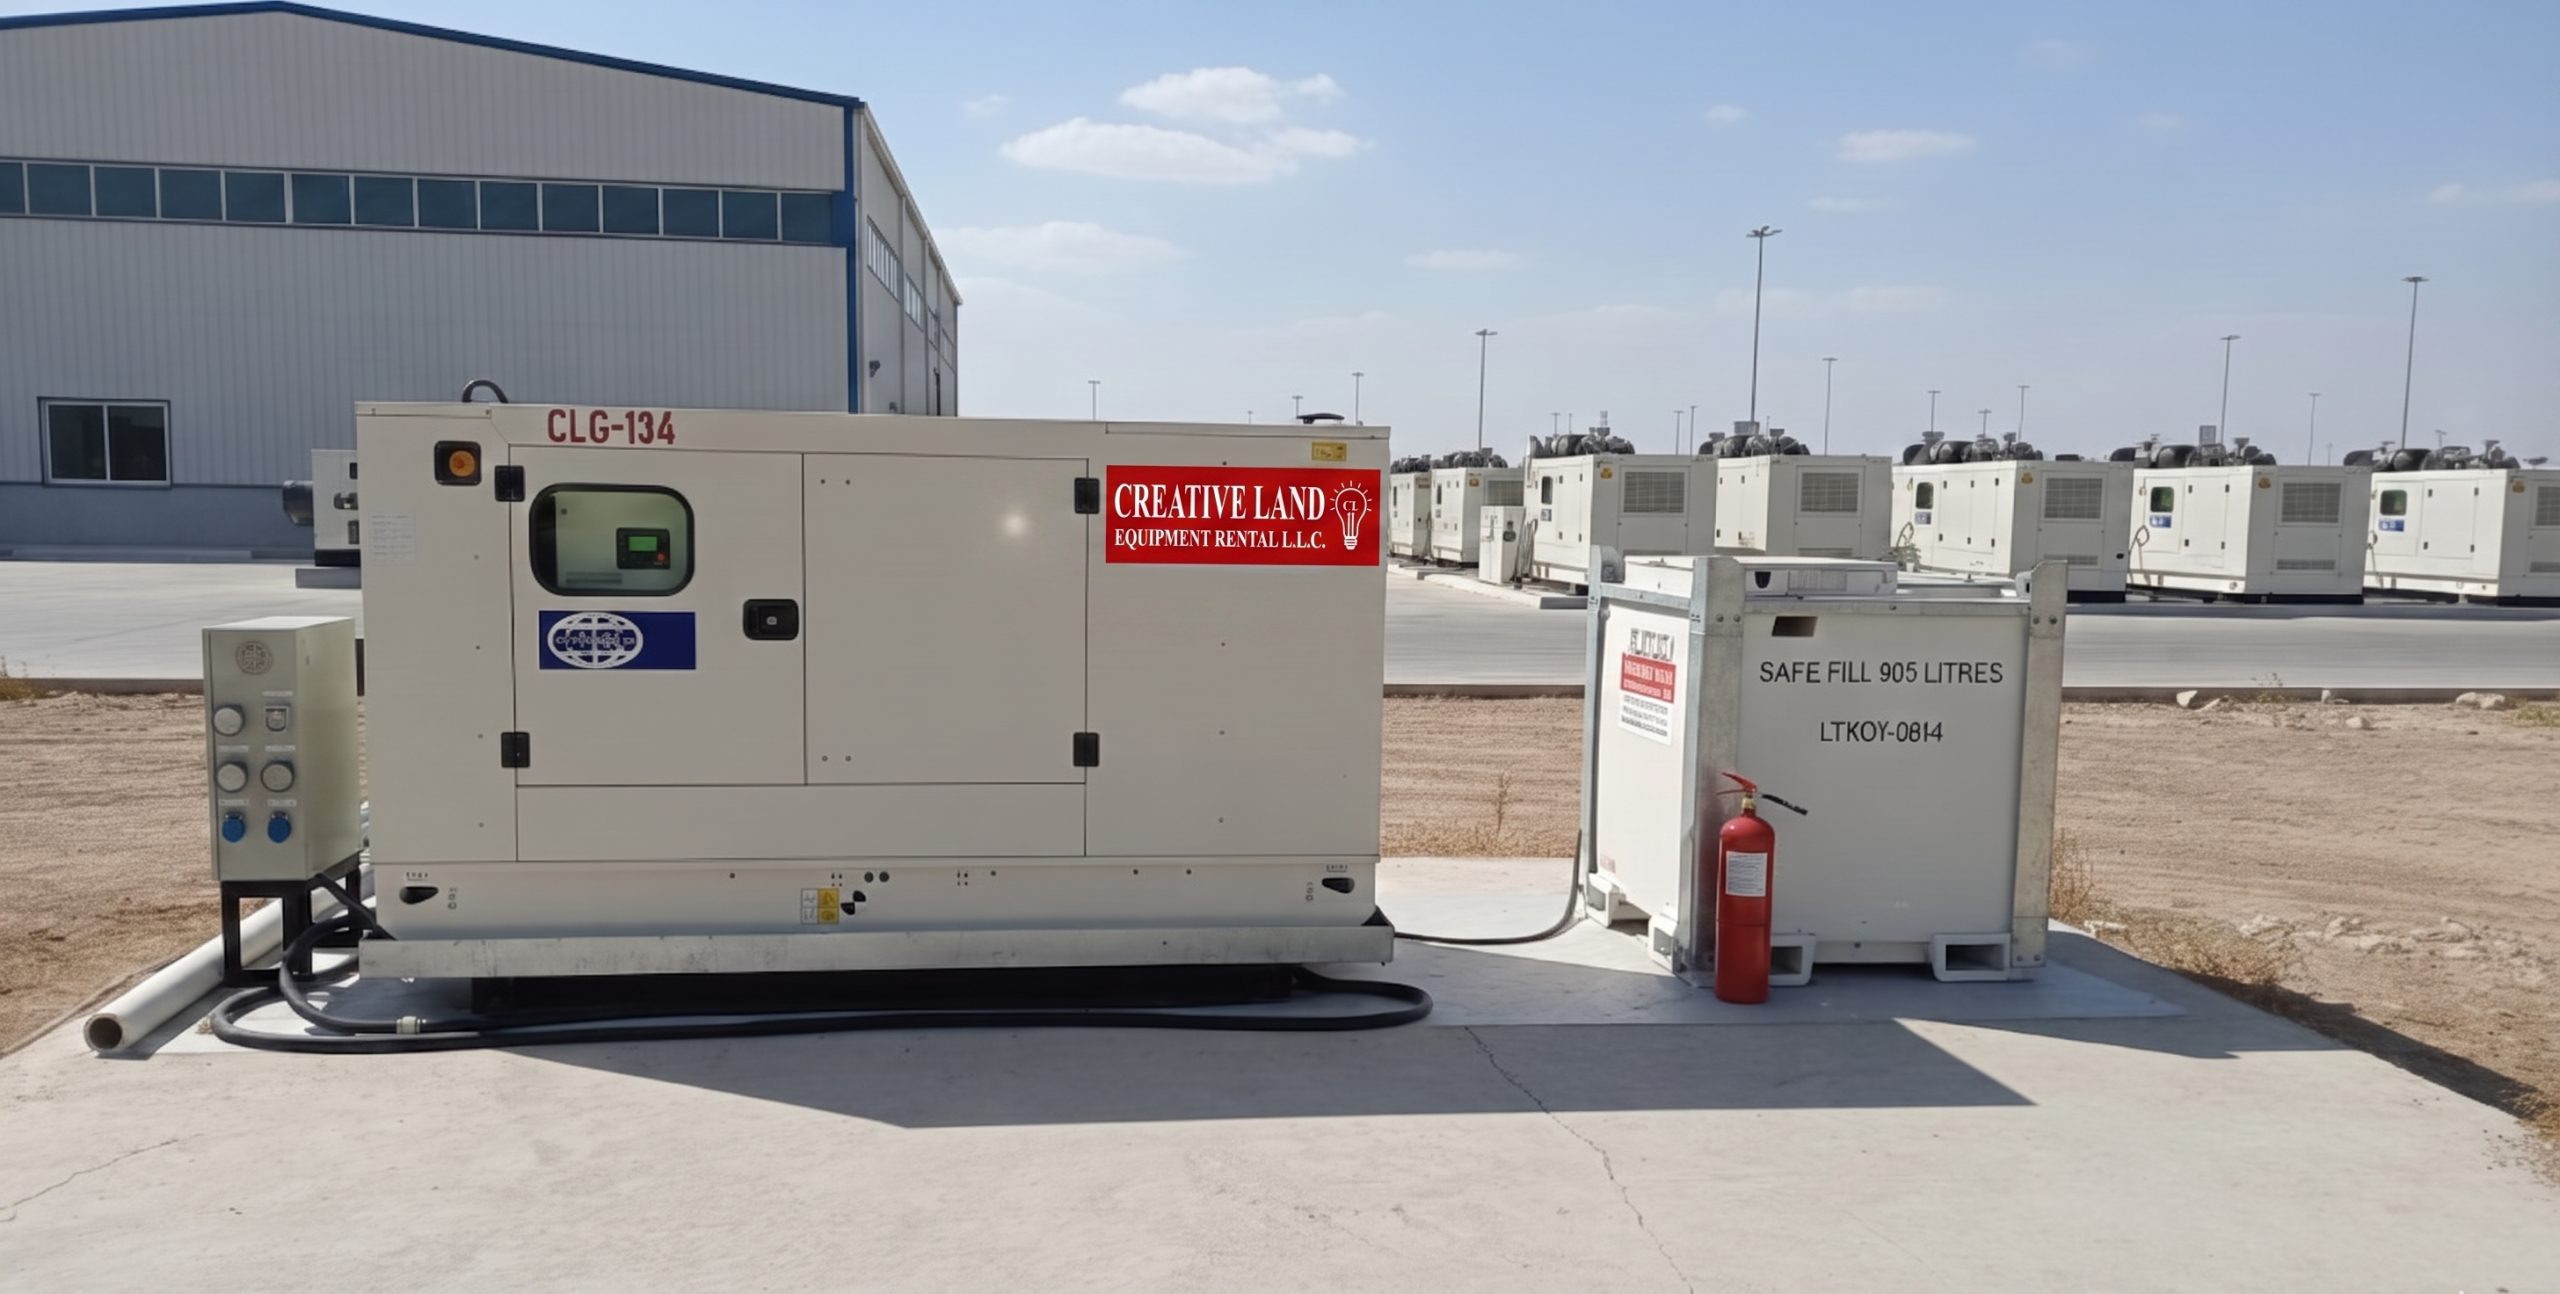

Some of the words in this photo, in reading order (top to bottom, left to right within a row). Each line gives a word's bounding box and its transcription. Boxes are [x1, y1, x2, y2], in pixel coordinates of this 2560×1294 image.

[547, 408, 676, 445] CLG-134
[1113, 483, 1247, 520] CREATIVE
[1253, 485, 1326, 521] LAND
[1114, 528, 1212, 551] EQUIPMENT
[1214, 530, 1279, 549] RENTAL
[1281, 531, 1326, 549] L.L.C.
[1759, 661, 1821, 684] SAFE
[1827, 661, 1872, 684] FILL
[1879, 661, 1918, 684] 905
[1924, 662, 2004, 684] LITRES
